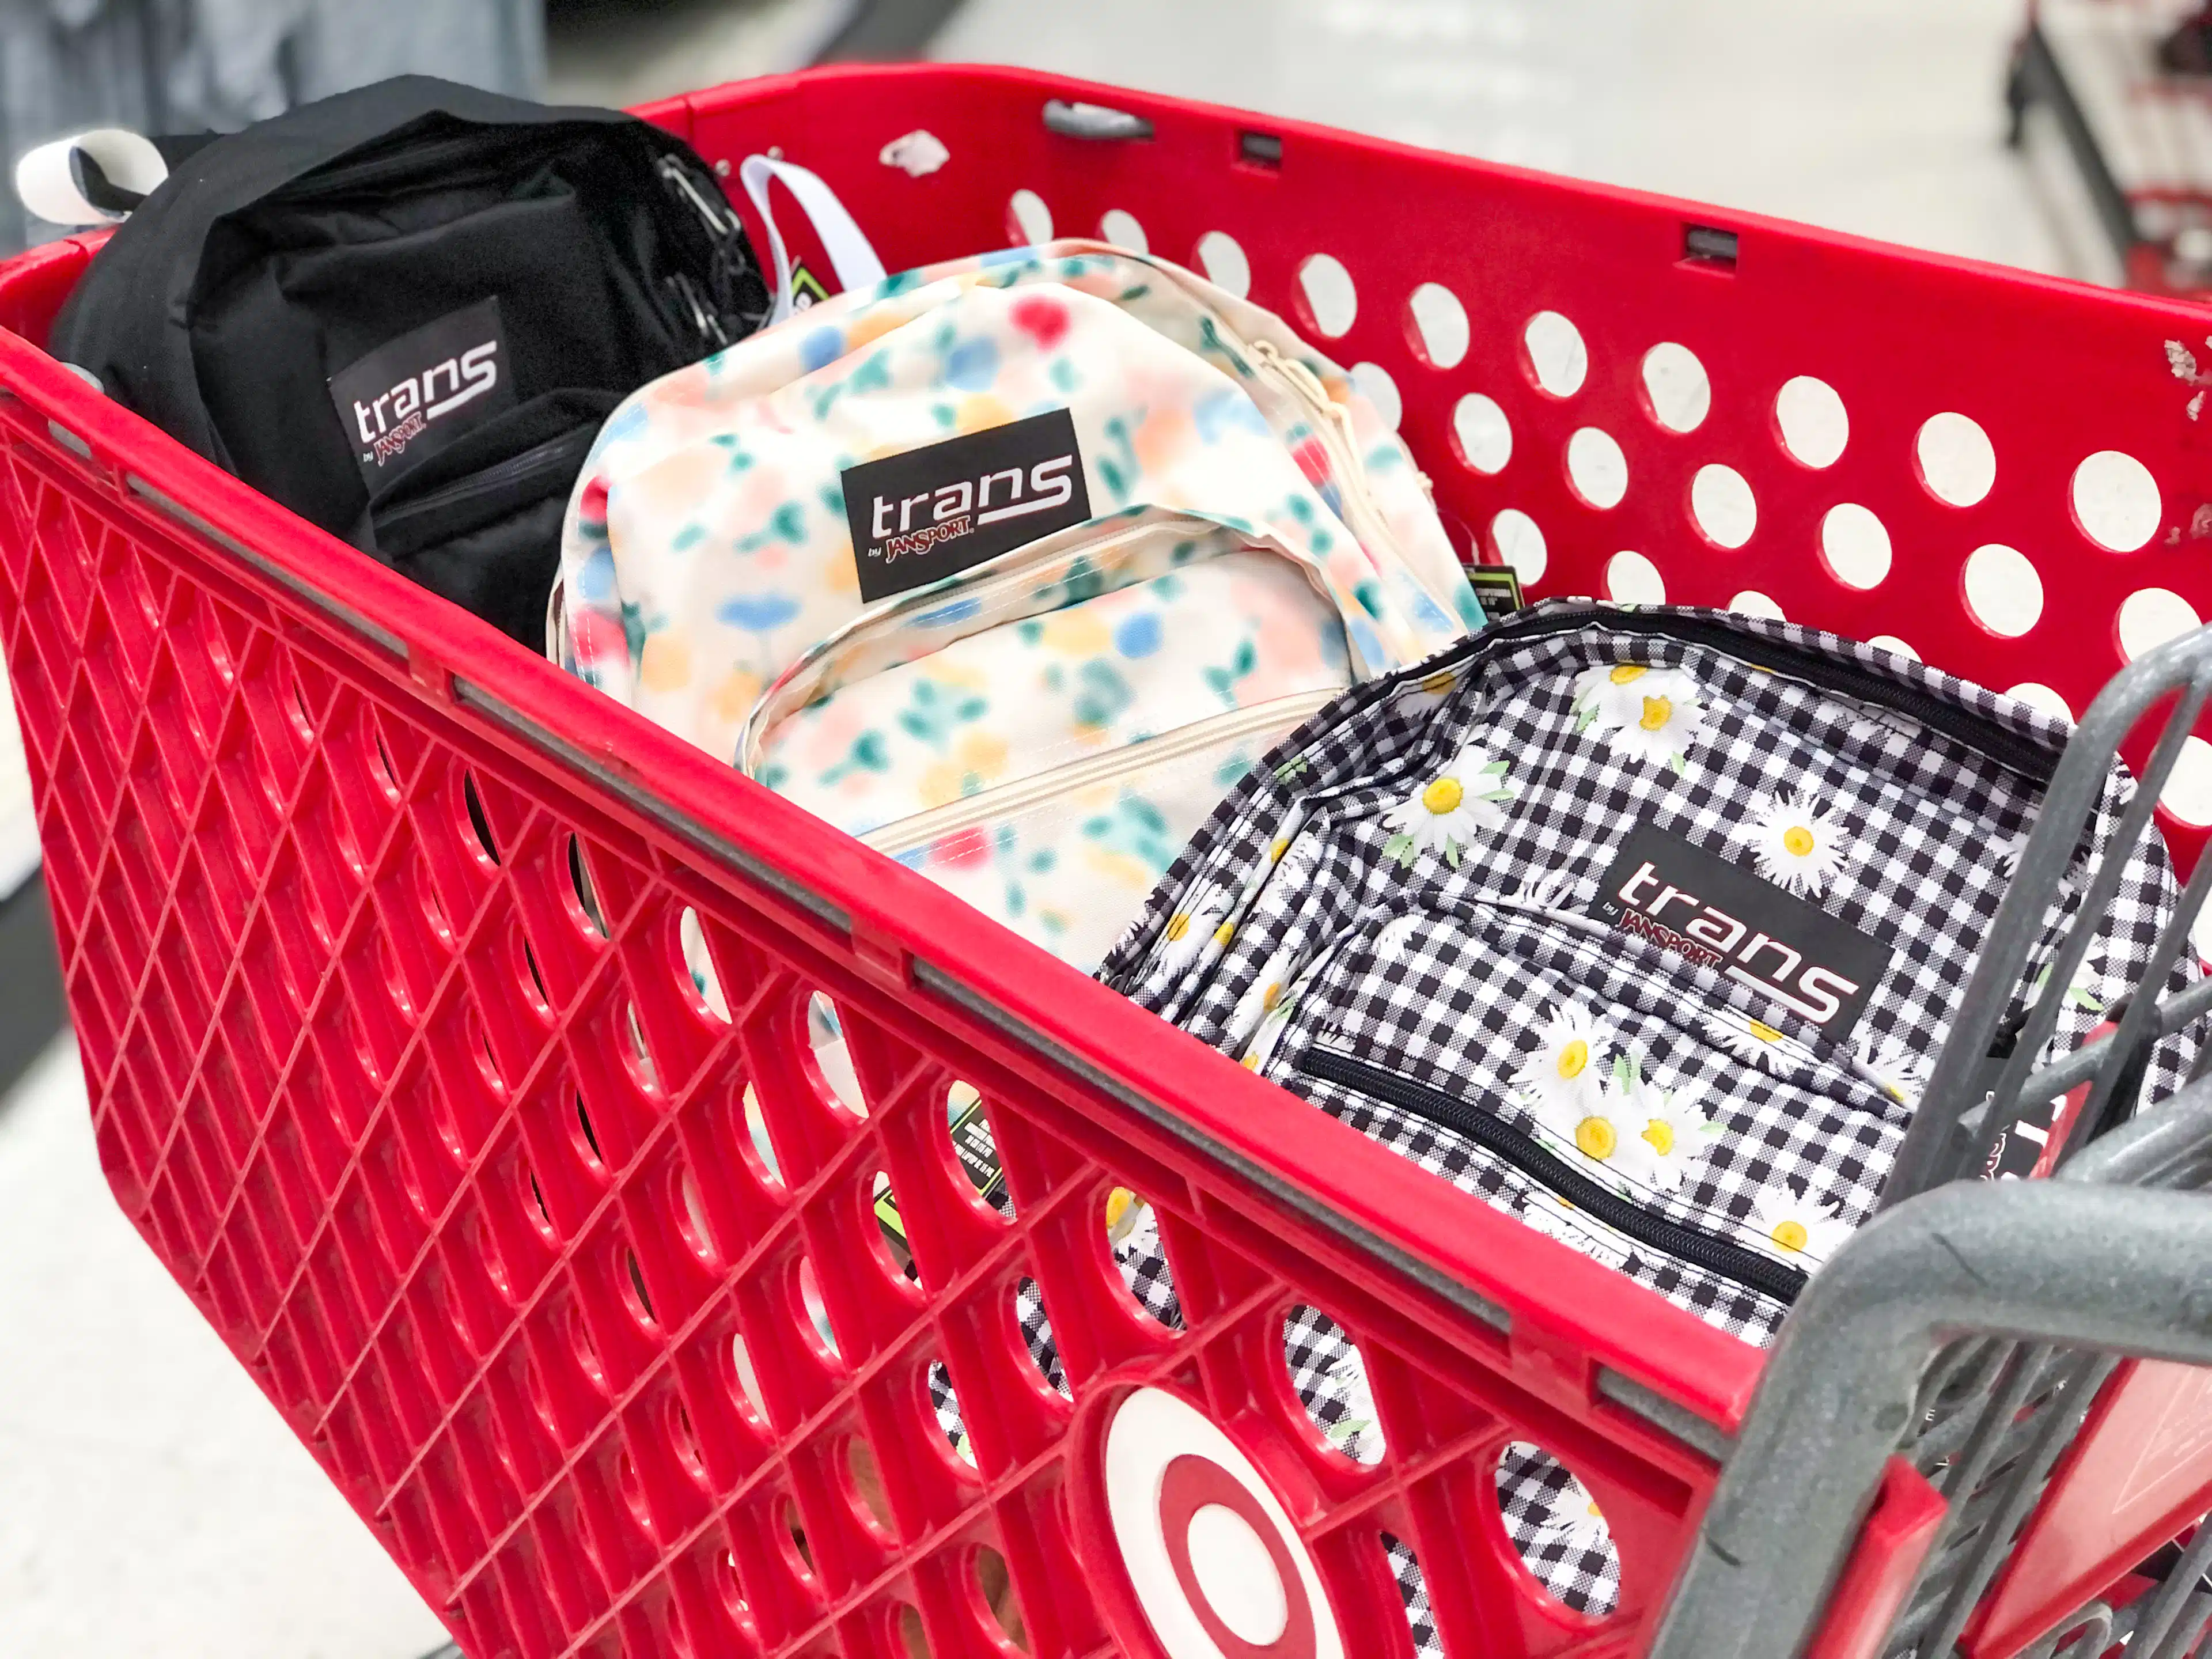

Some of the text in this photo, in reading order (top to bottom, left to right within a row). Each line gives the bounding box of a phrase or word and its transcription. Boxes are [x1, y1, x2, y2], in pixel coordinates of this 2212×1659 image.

[354, 340, 497, 444] trans
[362, 411, 422, 467] by JANSPORT
[872, 454, 1073, 538] trans
[868, 515, 971, 564] by JANSPORT
[1602, 901, 1724, 969] by JANSPORT
[1619, 861, 1859, 1024] trans
